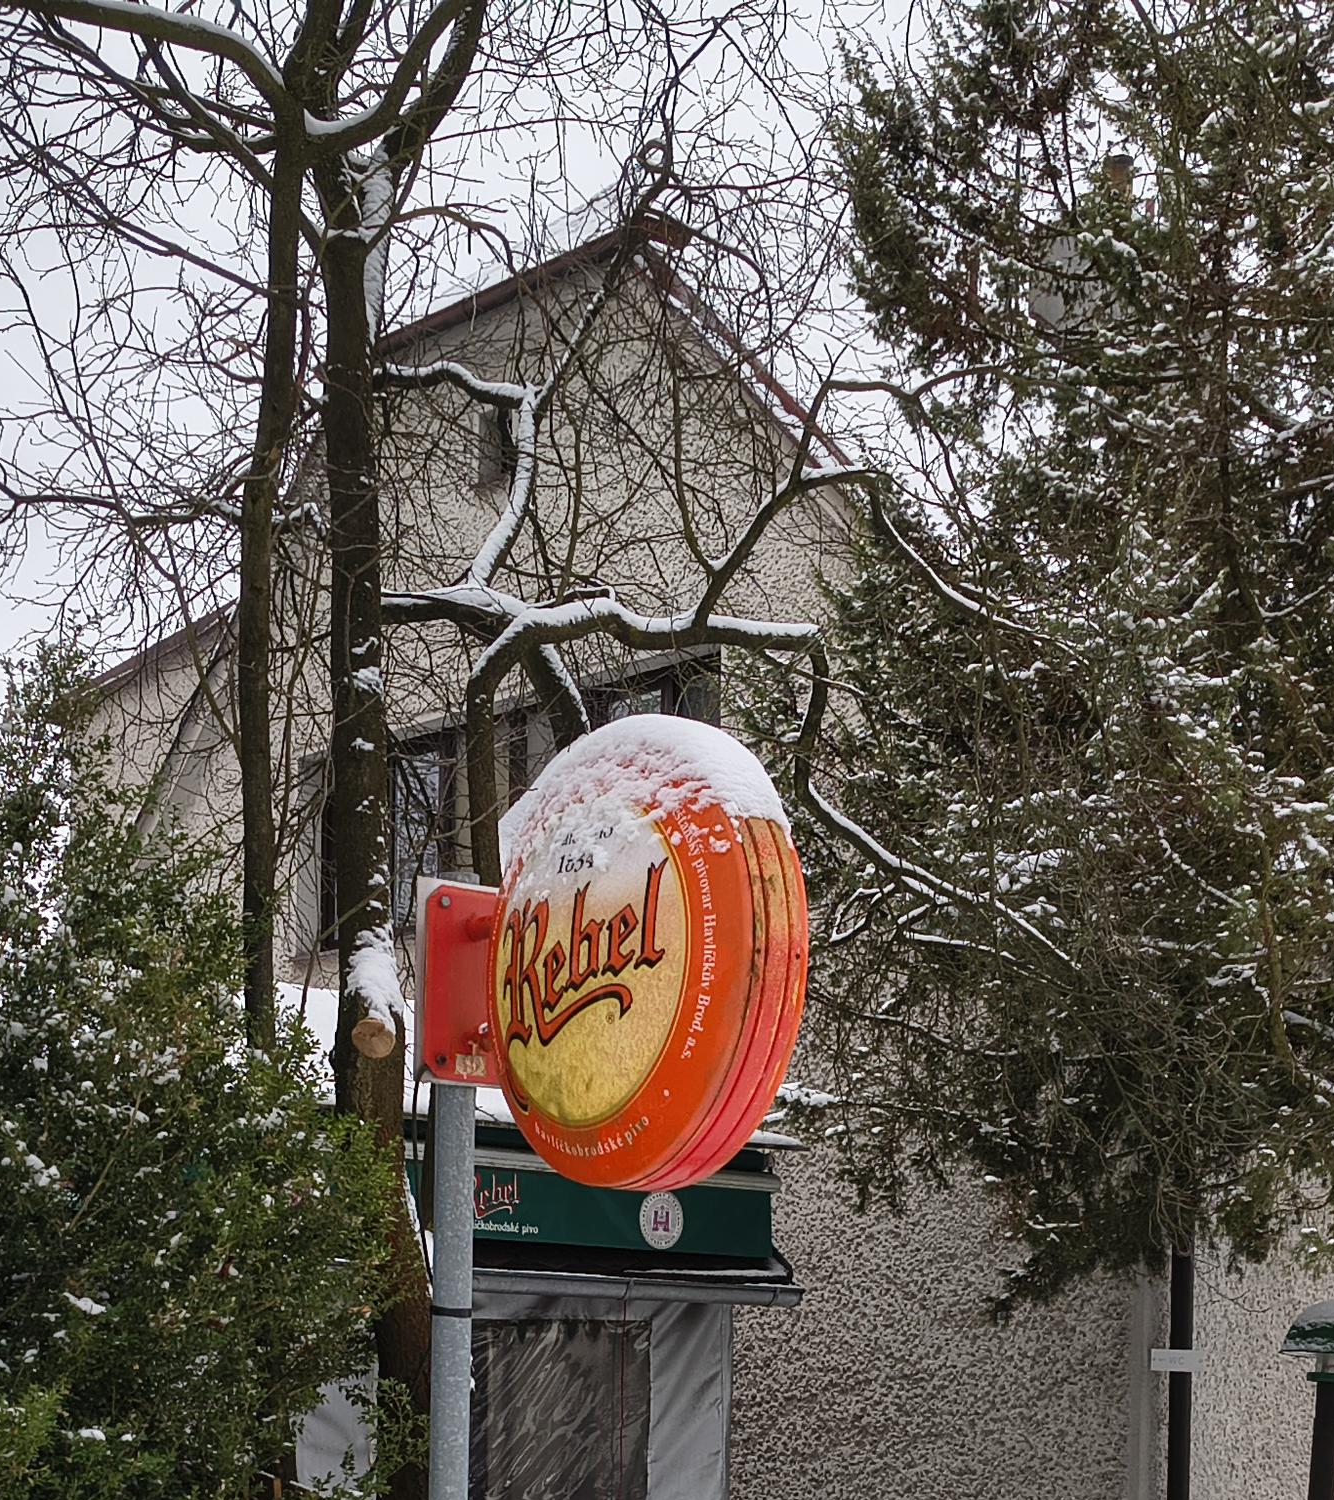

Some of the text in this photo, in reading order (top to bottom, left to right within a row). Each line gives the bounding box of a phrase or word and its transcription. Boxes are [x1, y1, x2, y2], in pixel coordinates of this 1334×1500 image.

[691, 857, 712, 910] pivovar
[503, 856, 669, 1047] Rebel
[701, 914, 716, 990] Havlíčkův
[688, 994, 711, 1033] Brod,
[681, 1036, 696, 1060] a.s.
[624, 1116, 649, 1144] pivo
[522, 1224, 539, 1236] pivo
